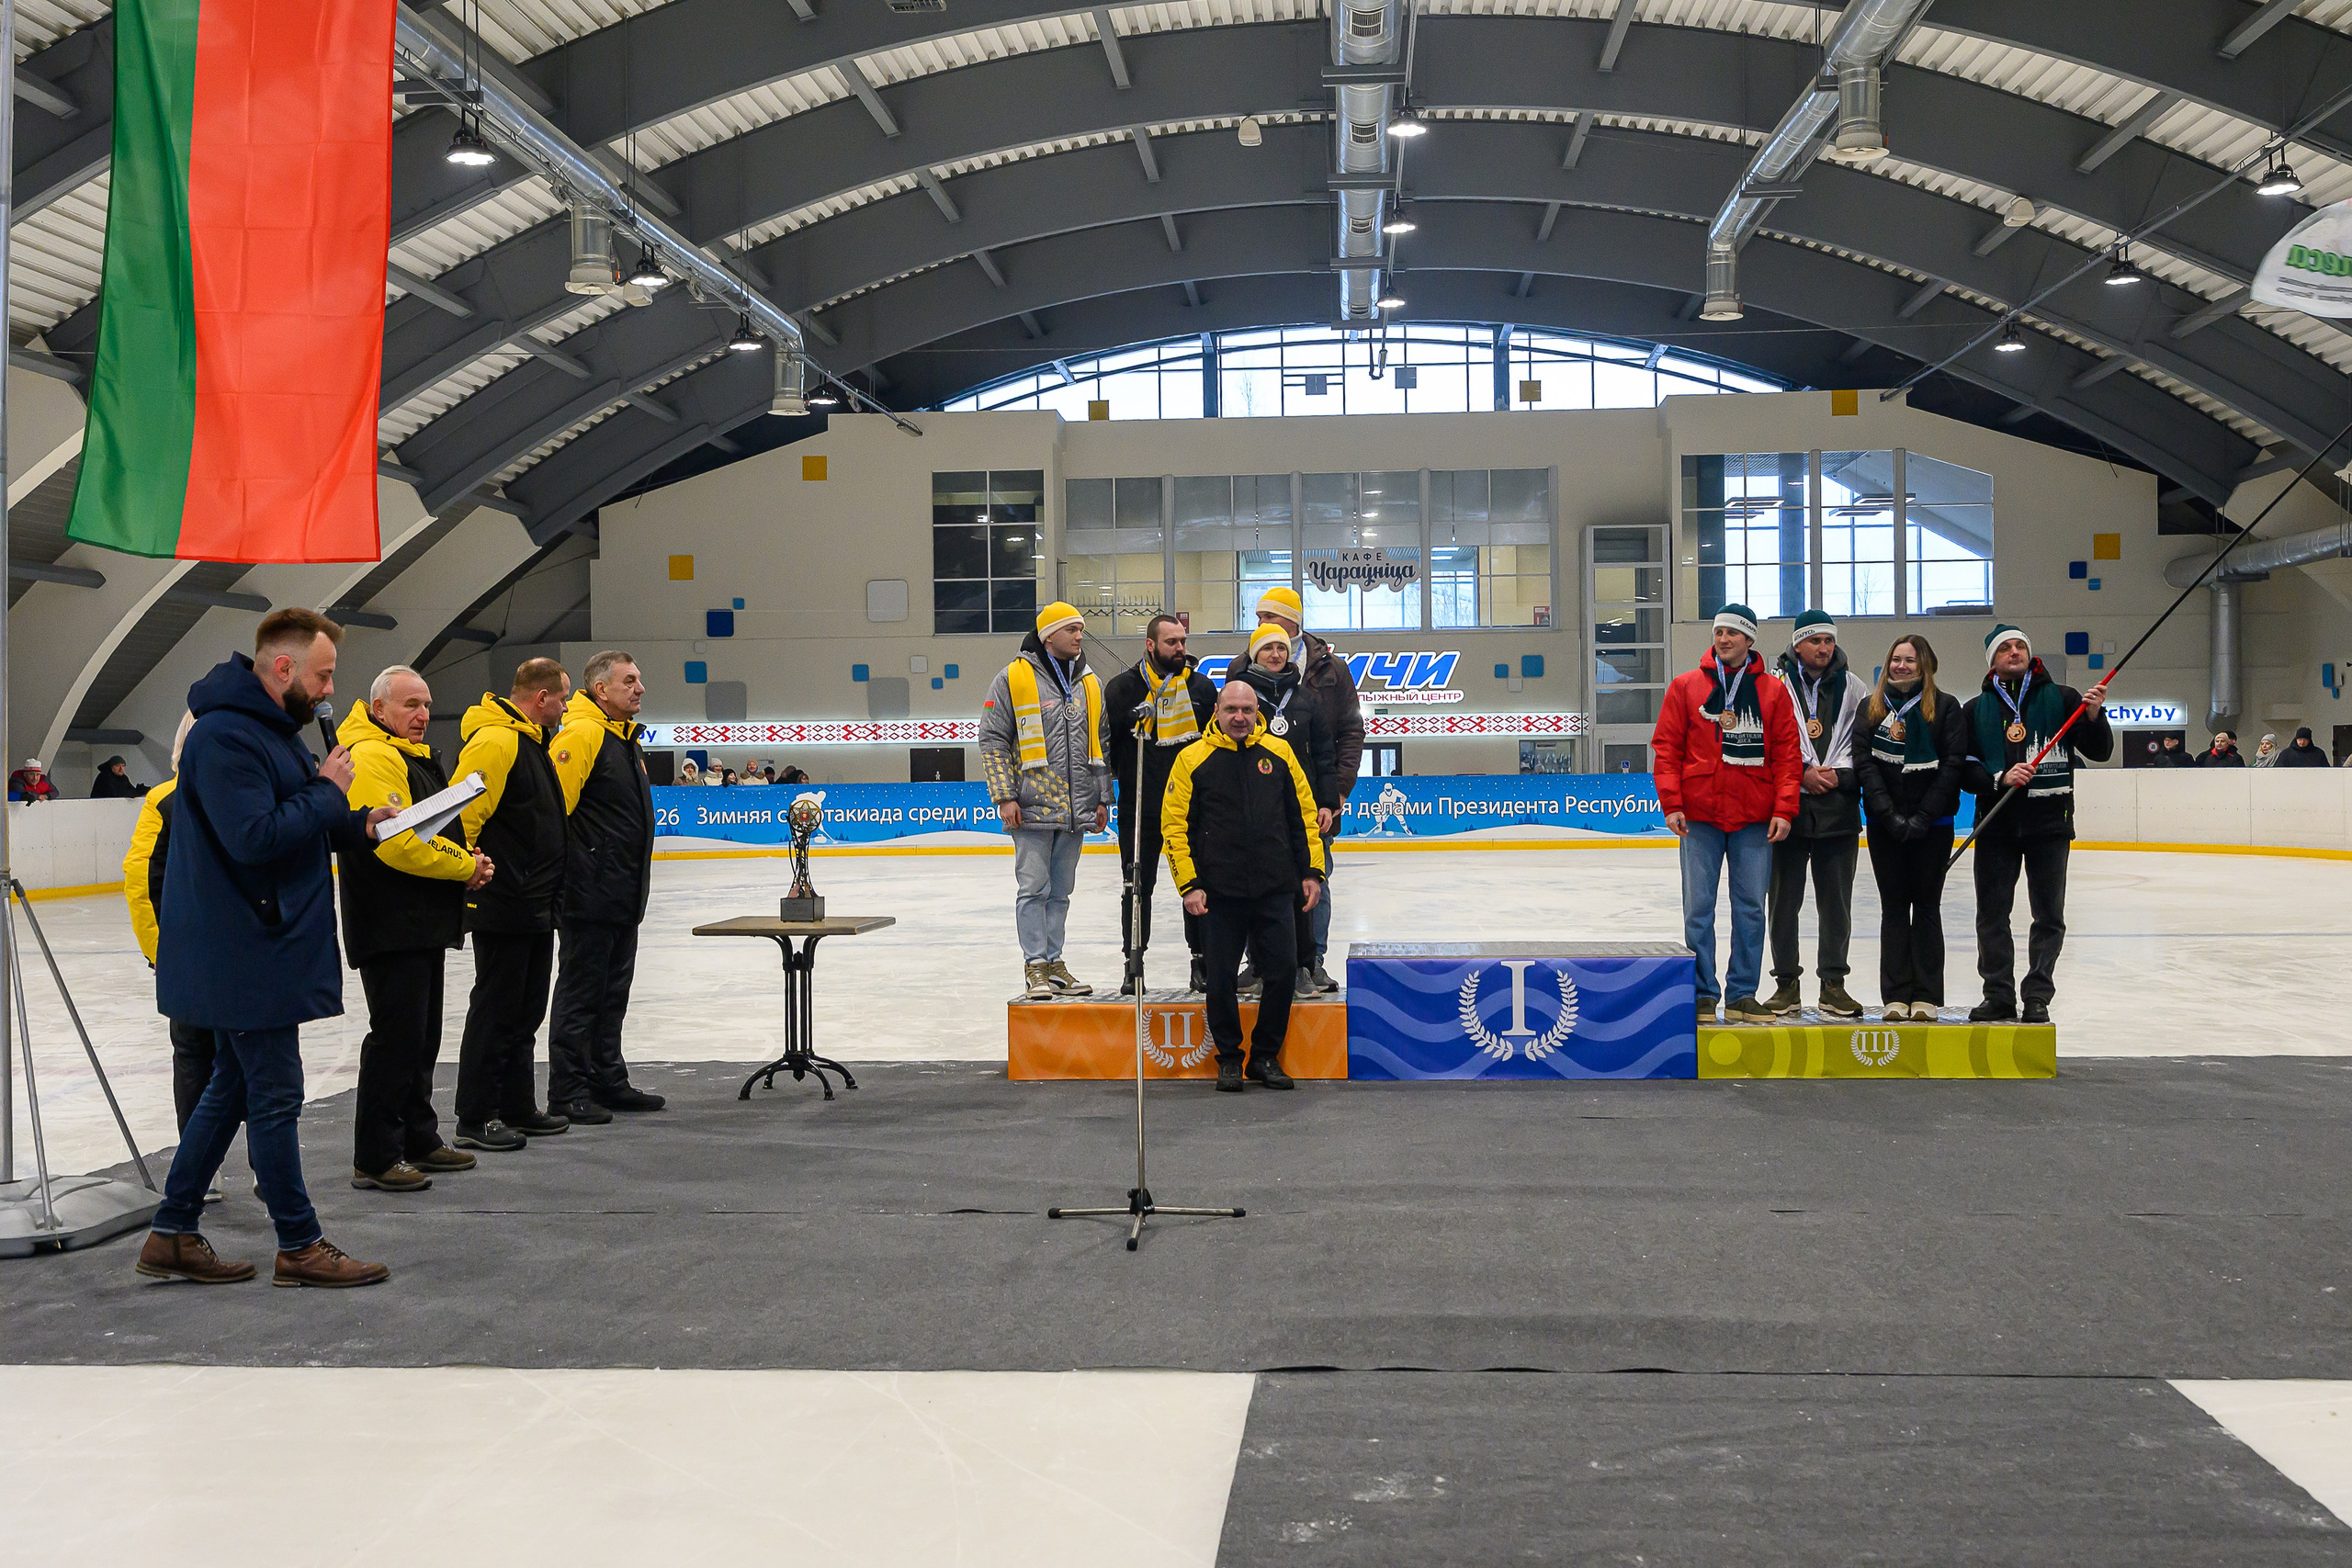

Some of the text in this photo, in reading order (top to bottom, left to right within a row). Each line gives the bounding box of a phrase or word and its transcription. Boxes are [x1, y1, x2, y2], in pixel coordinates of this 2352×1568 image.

[1342, 552, 1382, 562] КАФЕ
[1309, 561, 1416, 588] Чараўніца
[1358, 692, 1462, 703] ЛЫЖНЫЙ ЦЕНТР
[2105, 705, 2177, 721] chy.by
[656, 807, 680, 826] 26
[696, 807, 772, 826] Зимняя
[777, 806, 903, 825] стакиада
[908, 806, 967, 825] среди
[973, 806, 1001, 825] ра
[1357, 800, 1432, 820] делами
[1438, 796, 1559, 819] Президента
[1565, 795, 1662, 818] Республи
[1159, 1012, 1196, 1048] II
